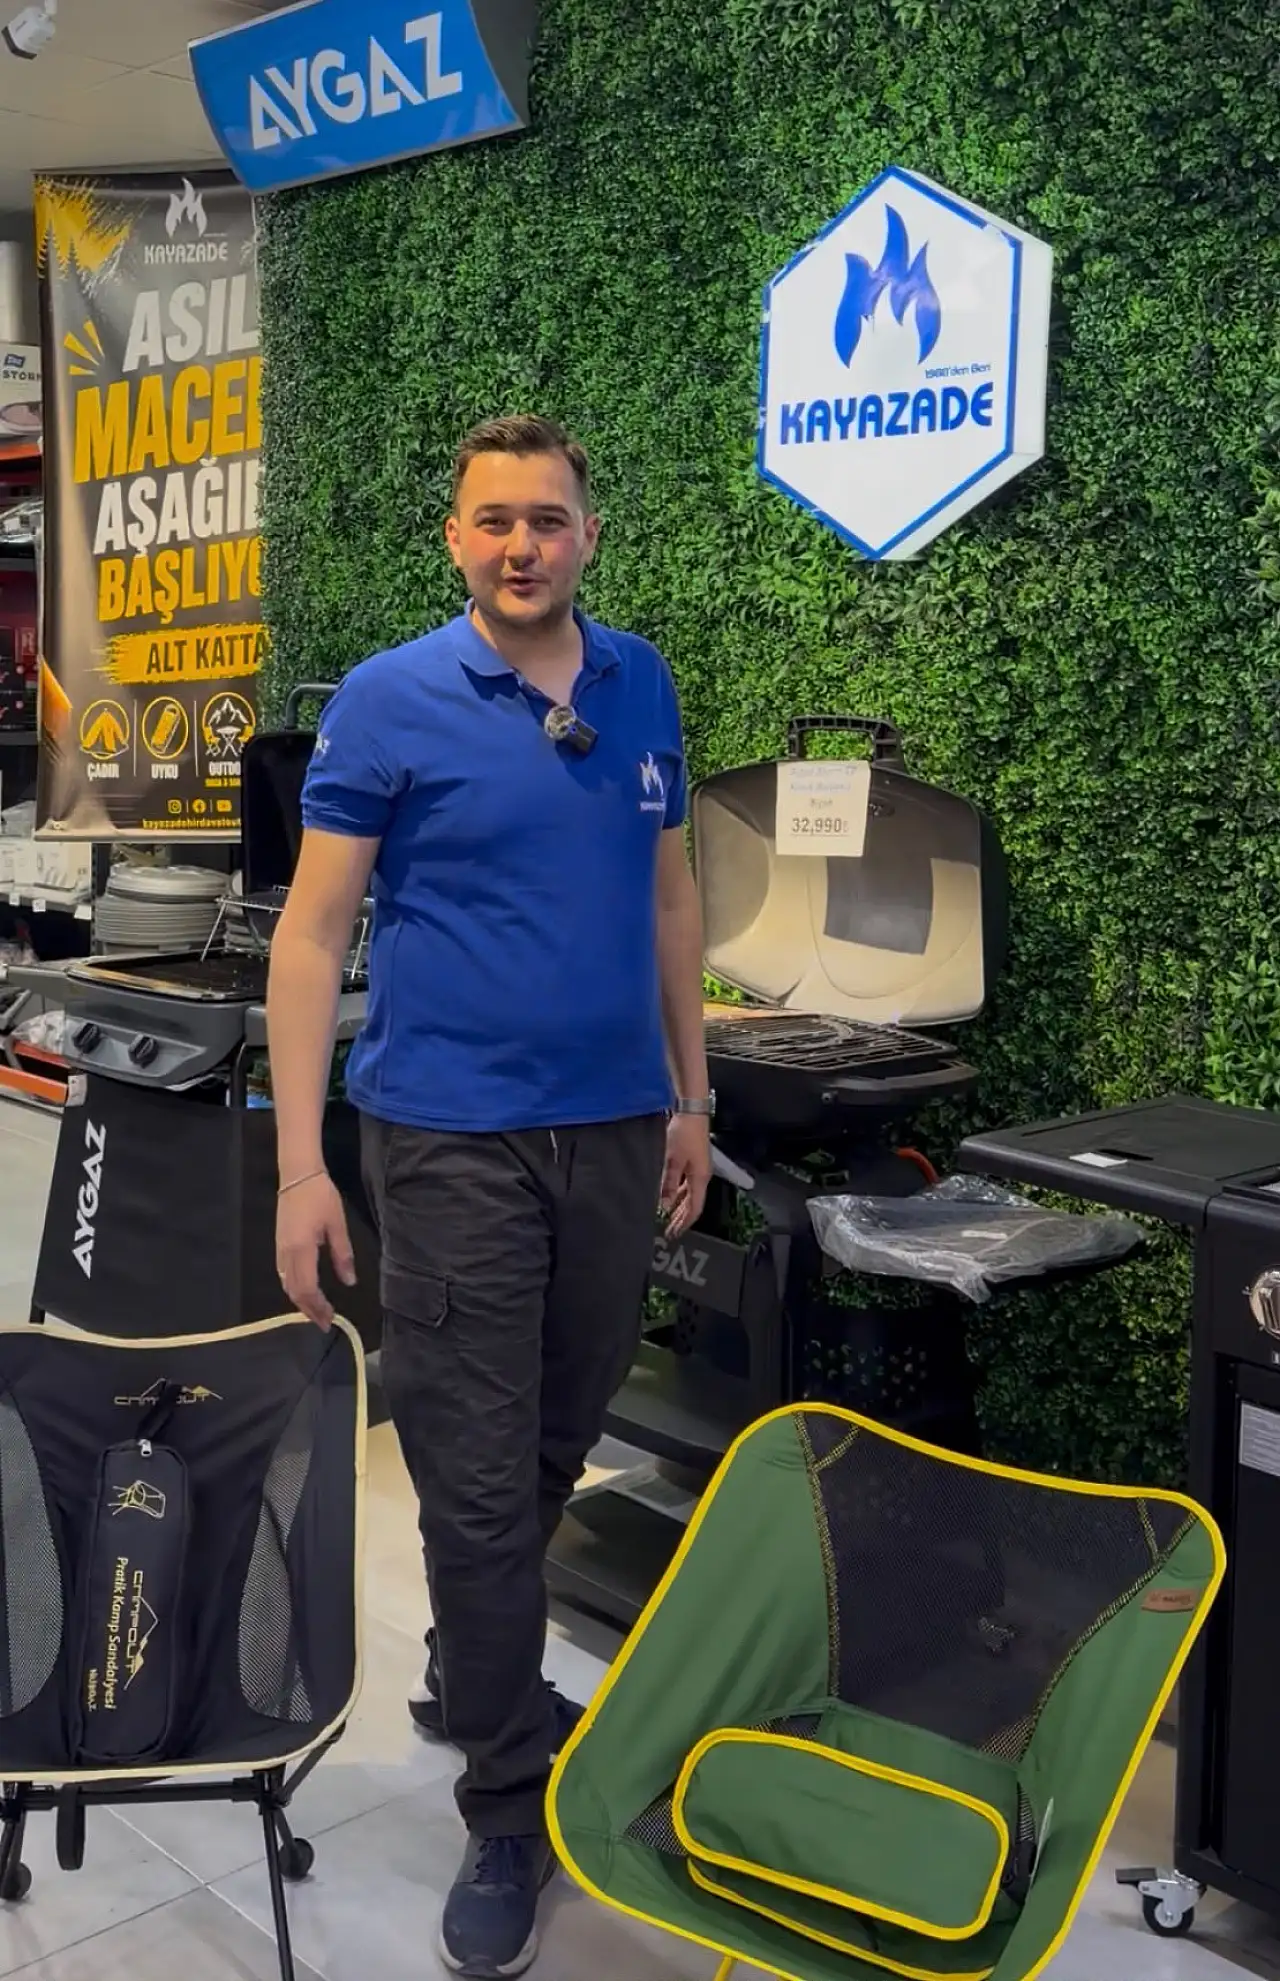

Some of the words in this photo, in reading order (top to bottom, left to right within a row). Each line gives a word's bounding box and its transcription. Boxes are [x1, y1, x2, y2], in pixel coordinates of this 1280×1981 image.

[249, 12, 463, 150] AYGAZ
[144, 242, 229, 265] KAYAZADE
[122, 273, 263, 372] ASIL
[780, 381, 994, 446] KAYAZADE
[146, 637, 188, 676] ALT
[71, 1118, 107, 1280] AYGAZ
[112, 1556, 129, 1594] Pratik
[107, 1595, 126, 1633] Kamp
[102, 1633, 121, 1709] Sandalyesi
